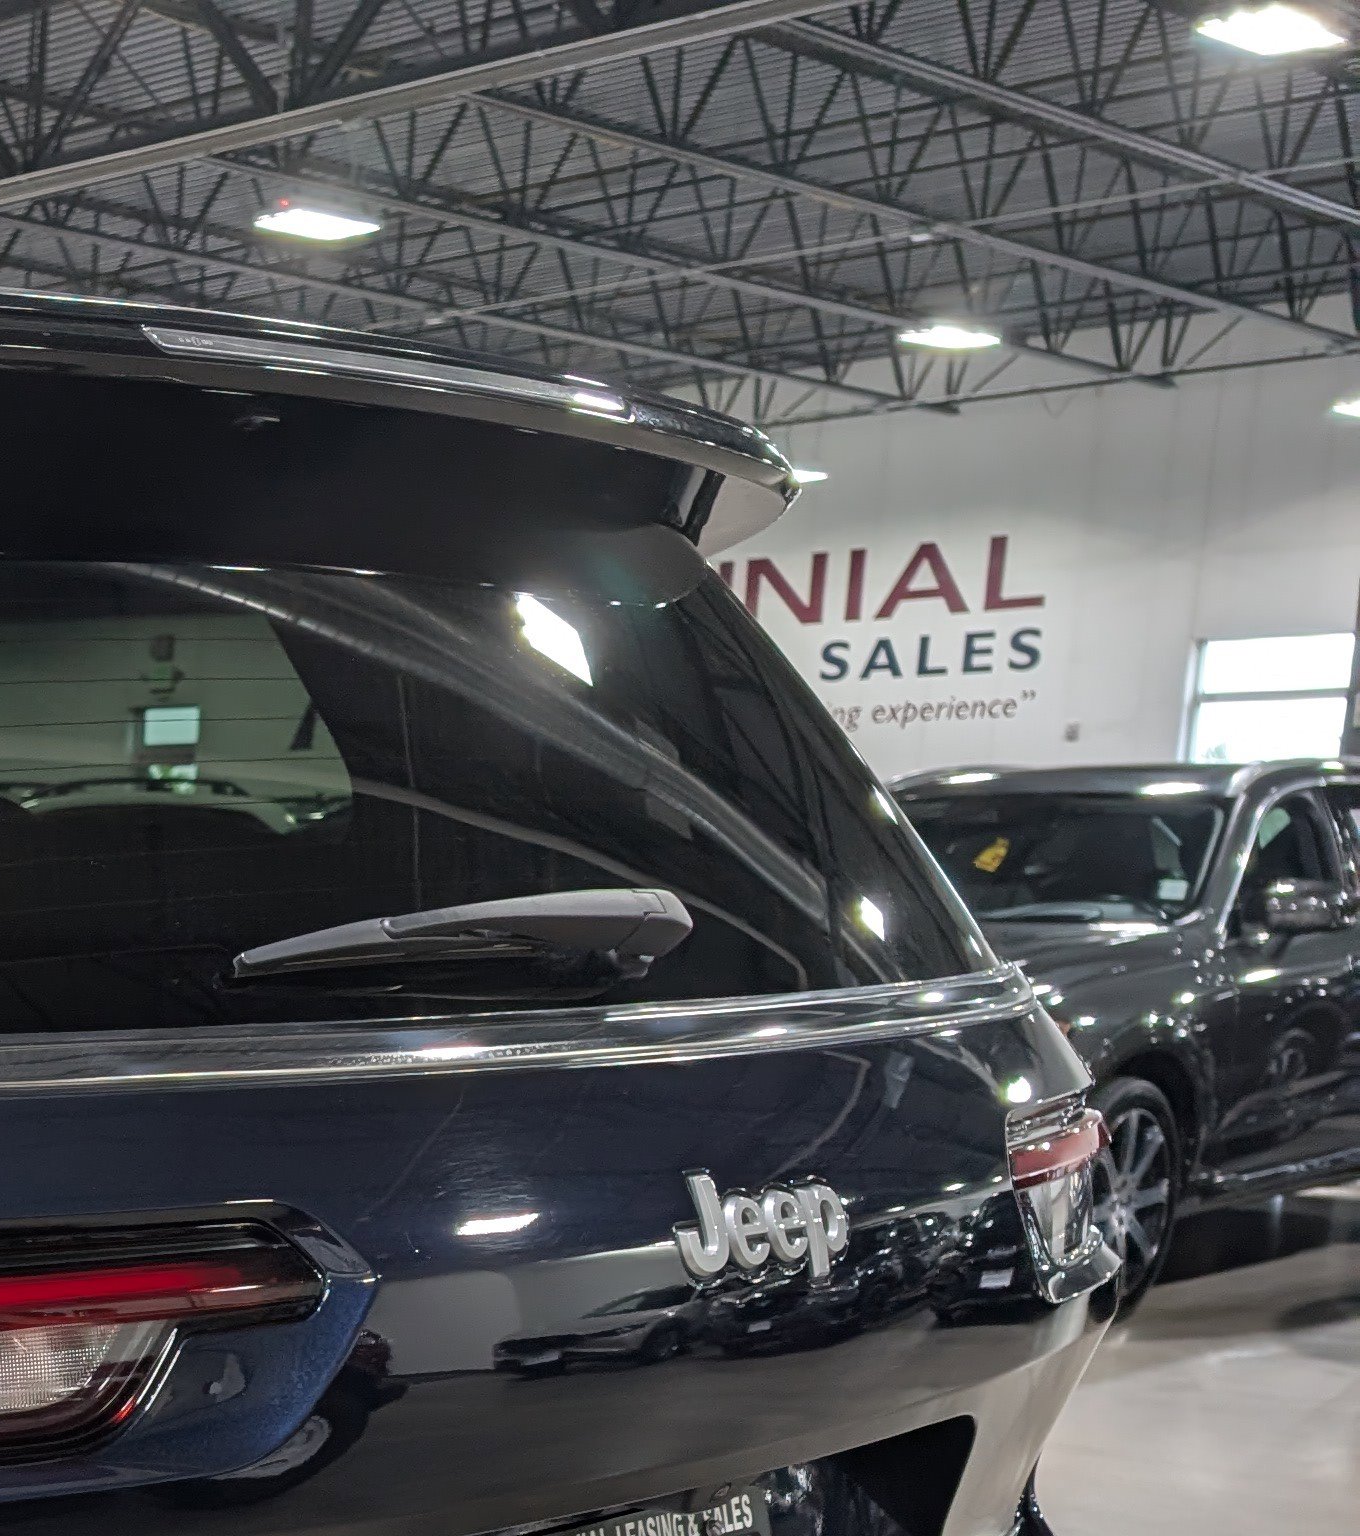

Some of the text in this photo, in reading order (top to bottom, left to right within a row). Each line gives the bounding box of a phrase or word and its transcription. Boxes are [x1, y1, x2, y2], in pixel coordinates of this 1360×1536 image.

[720, 534, 1046, 625] NIAL
[819, 627, 1042, 681] SALES
[673, 1168, 850, 1286] Jeep
